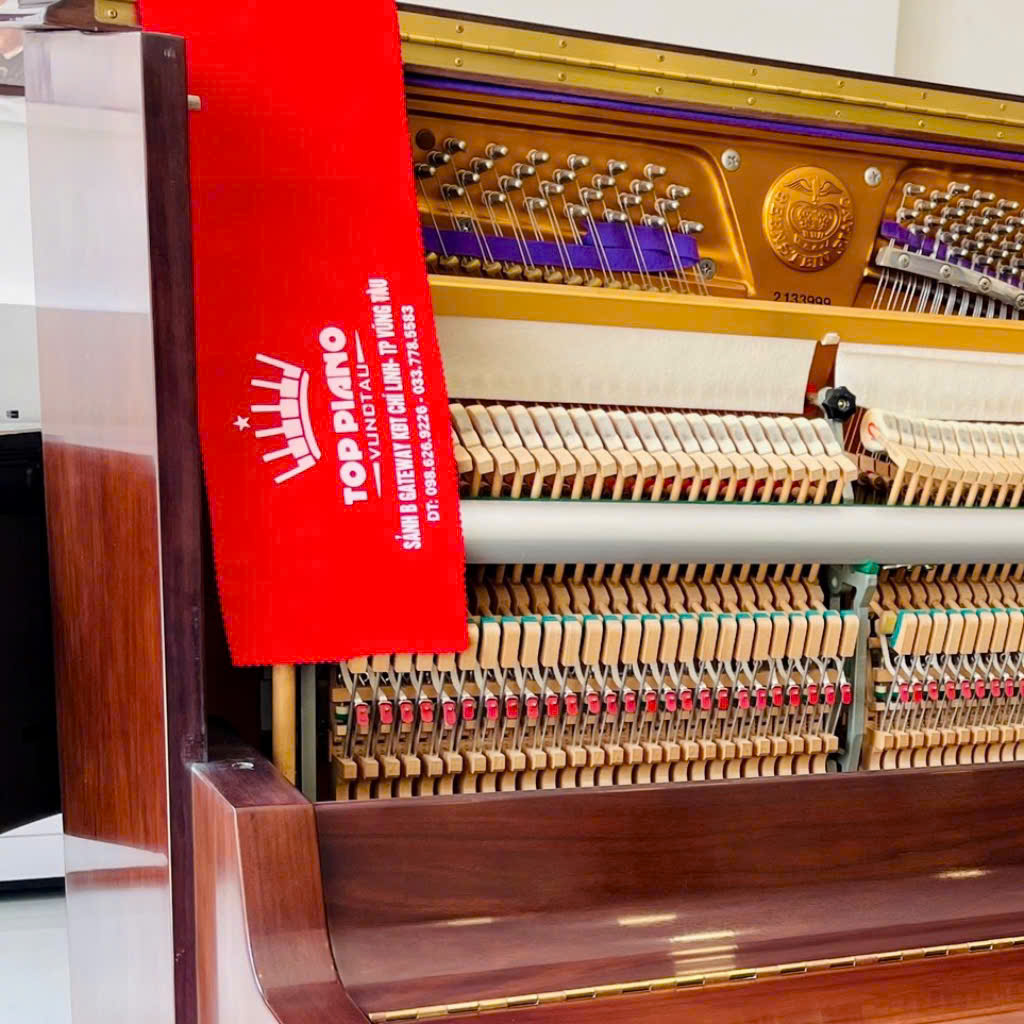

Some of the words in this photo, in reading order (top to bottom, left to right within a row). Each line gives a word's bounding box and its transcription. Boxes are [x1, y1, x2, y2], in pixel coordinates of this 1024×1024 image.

[318, 326, 359, 433] PIANO
[378, 341, 397, 356] TP
[336, 437, 368, 505] TOP
[392, 444, 417, 501] GATEWAY
[415, 406, 438, 496] 098.626.9226
